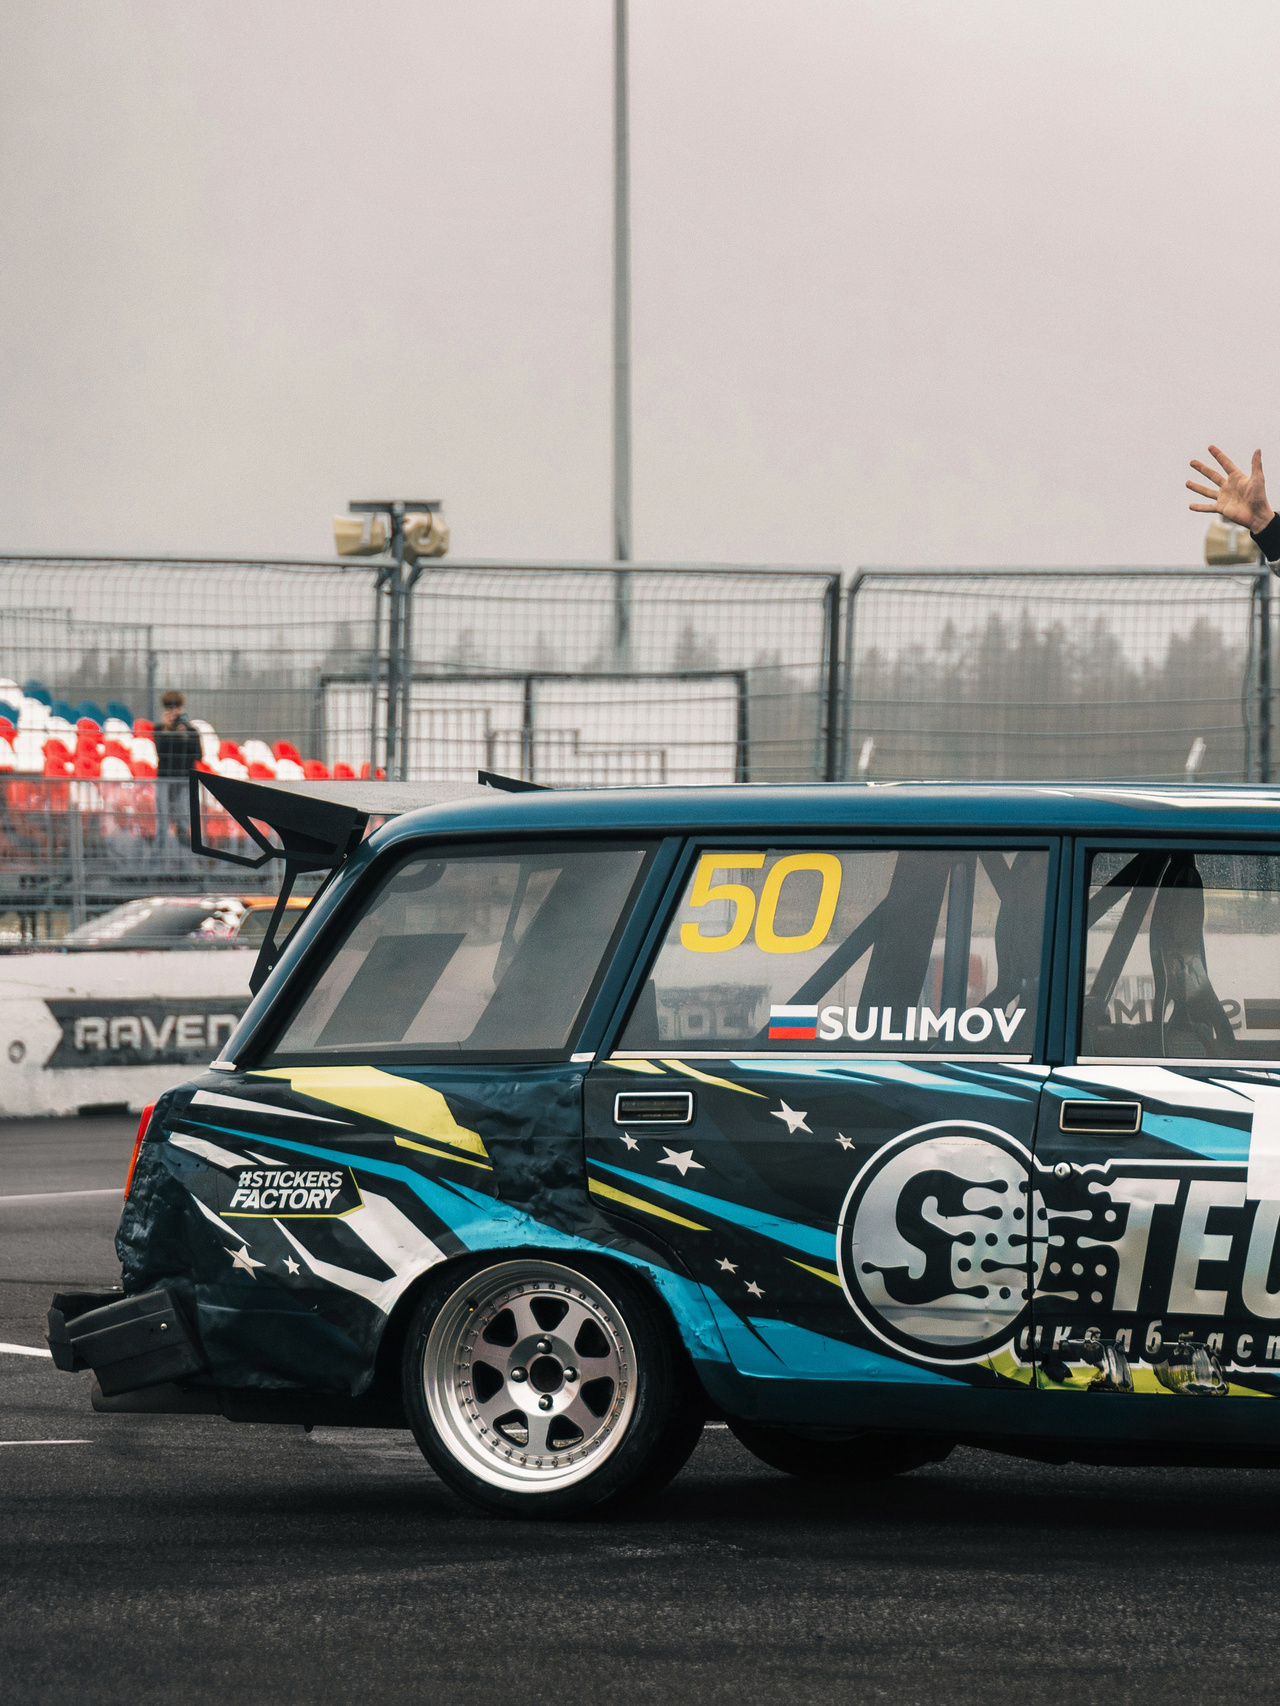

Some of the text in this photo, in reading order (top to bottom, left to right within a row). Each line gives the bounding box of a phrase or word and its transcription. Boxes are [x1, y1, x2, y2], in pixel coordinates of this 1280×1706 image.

[679, 852, 843, 954] 50
[818, 1005, 1027, 1043] SULIMOV
[238, 1171, 344, 1188] #STICKERS
[229, 1188, 341, 1210] FACTORY
